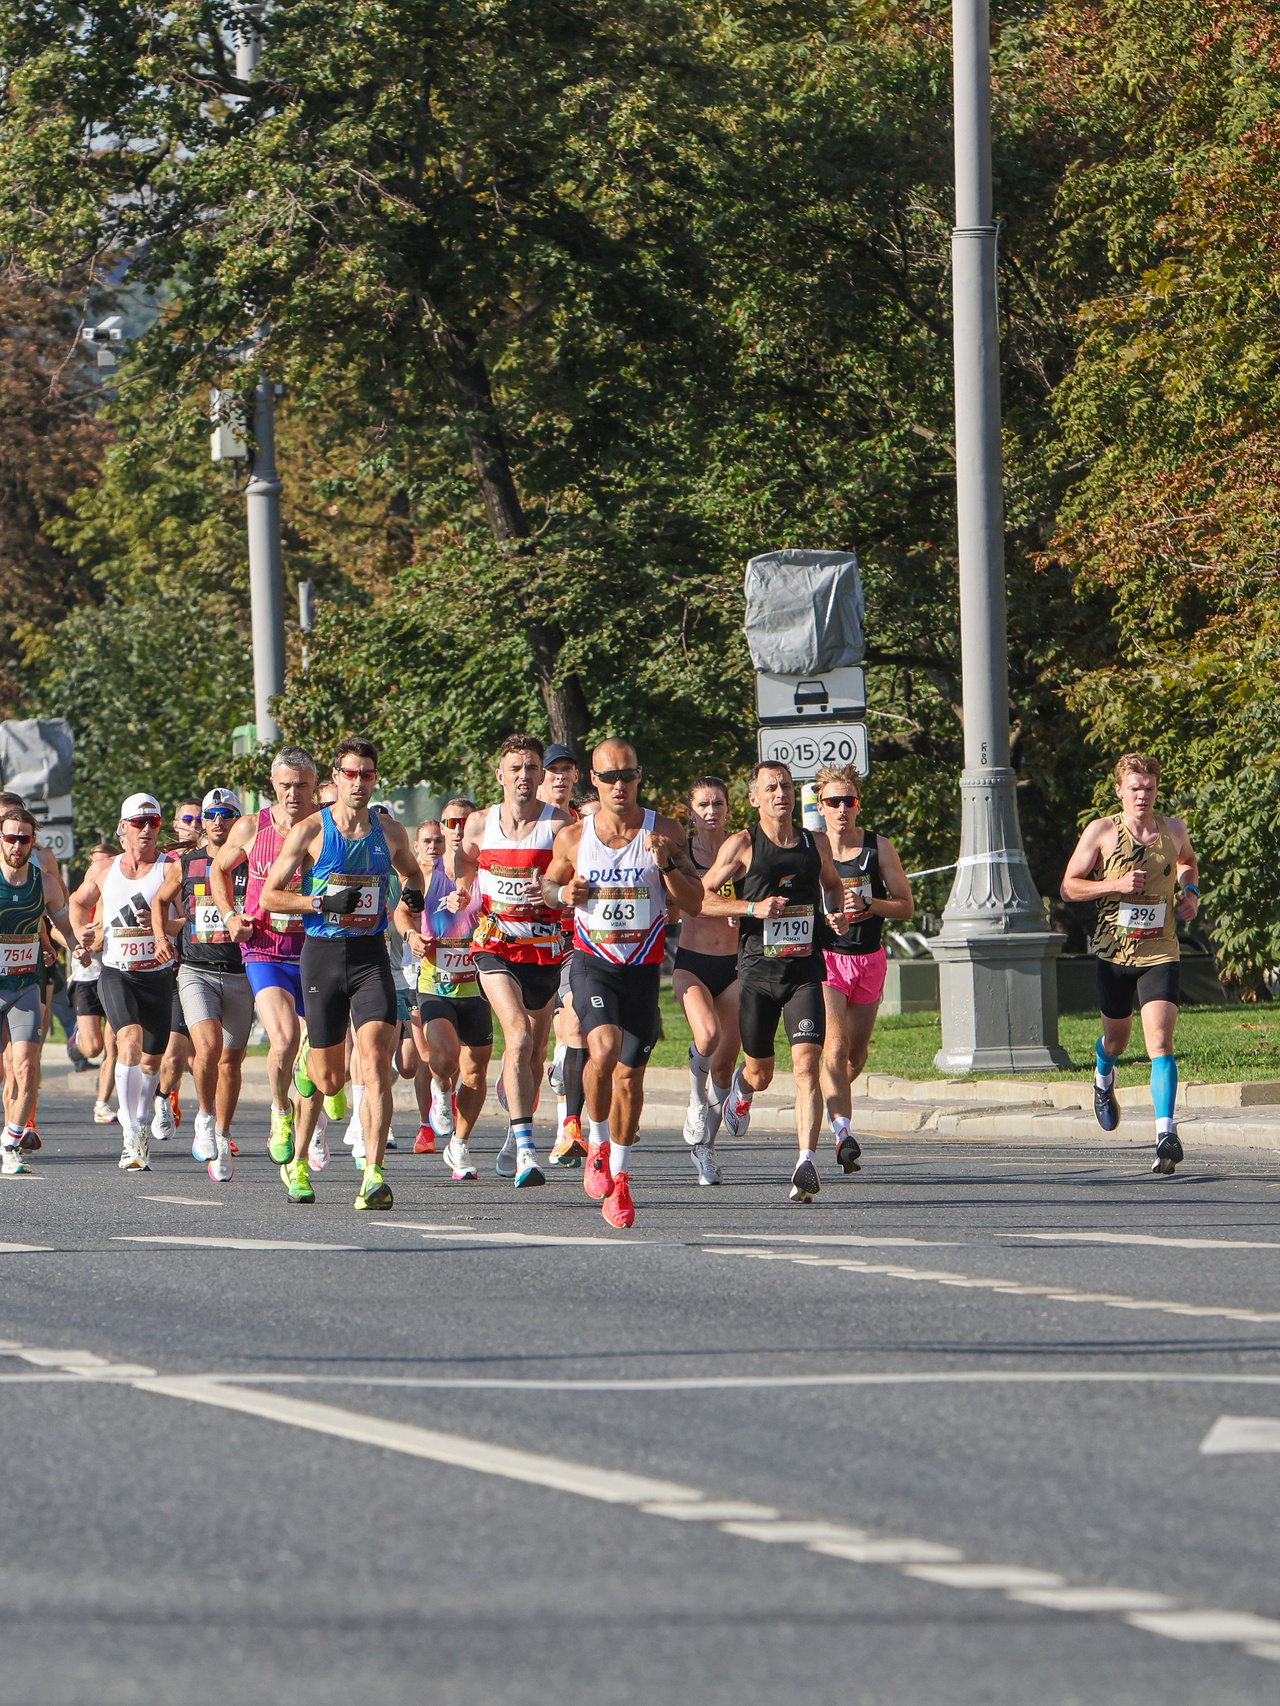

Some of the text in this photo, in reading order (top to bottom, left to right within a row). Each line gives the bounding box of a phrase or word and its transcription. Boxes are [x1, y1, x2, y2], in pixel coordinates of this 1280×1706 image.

[773, 740, 852, 762] 10 15 20
[46, 836, 64, 849] 20
[590, 868, 644, 883] DUSTY
[203, 910, 223, 923] 66
[602, 904, 635, 920] 663
[1130, 908, 1156, 921] 396
[772, 921, 809, 936] 7190
[4, 948, 32, 962] 7514
[121, 942, 156, 956] 7813
